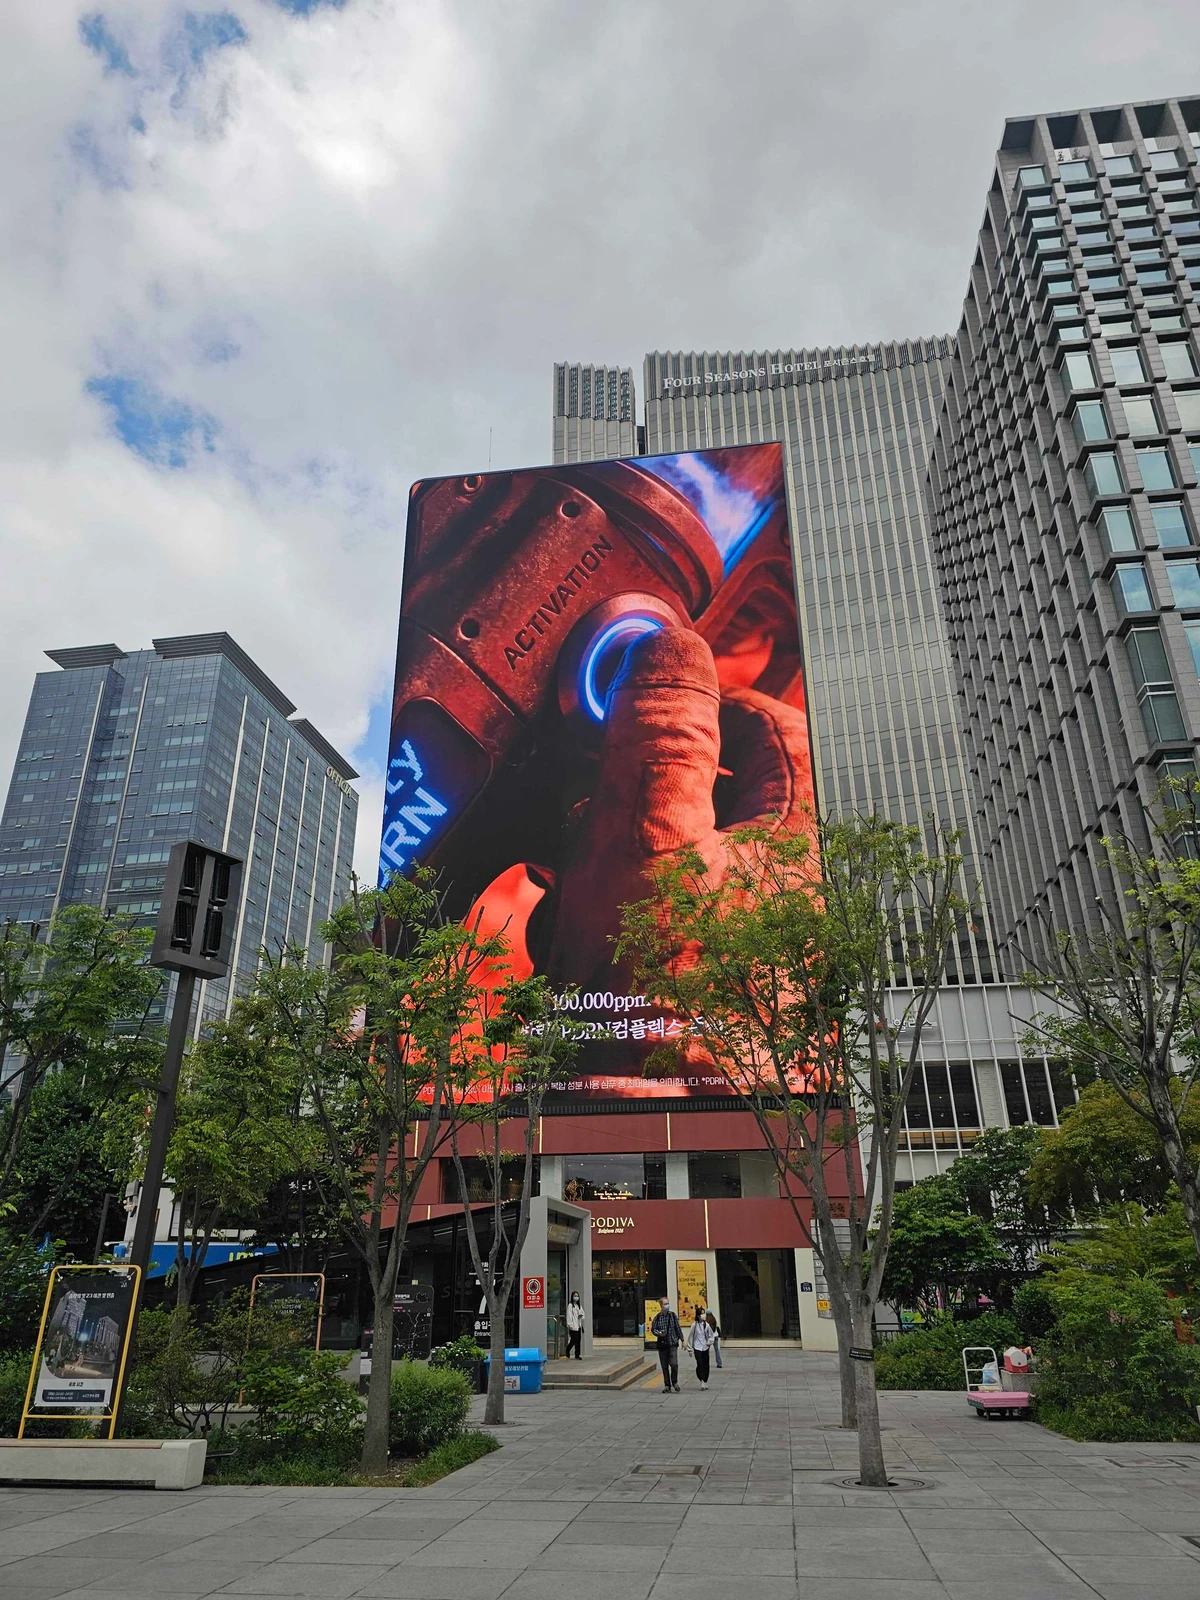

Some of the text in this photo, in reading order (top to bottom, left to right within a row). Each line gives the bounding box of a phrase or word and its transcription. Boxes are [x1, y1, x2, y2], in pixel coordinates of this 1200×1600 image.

[663, 360, 821, 389] FOUR SEASONS HOTEL
[503, 534, 613, 672] ACTIVATION
[567, 1081, 582, 1090] 성분
[584, 1080, 599, 1089] 사용
[591, 1217, 635, 1228] GODIVA
